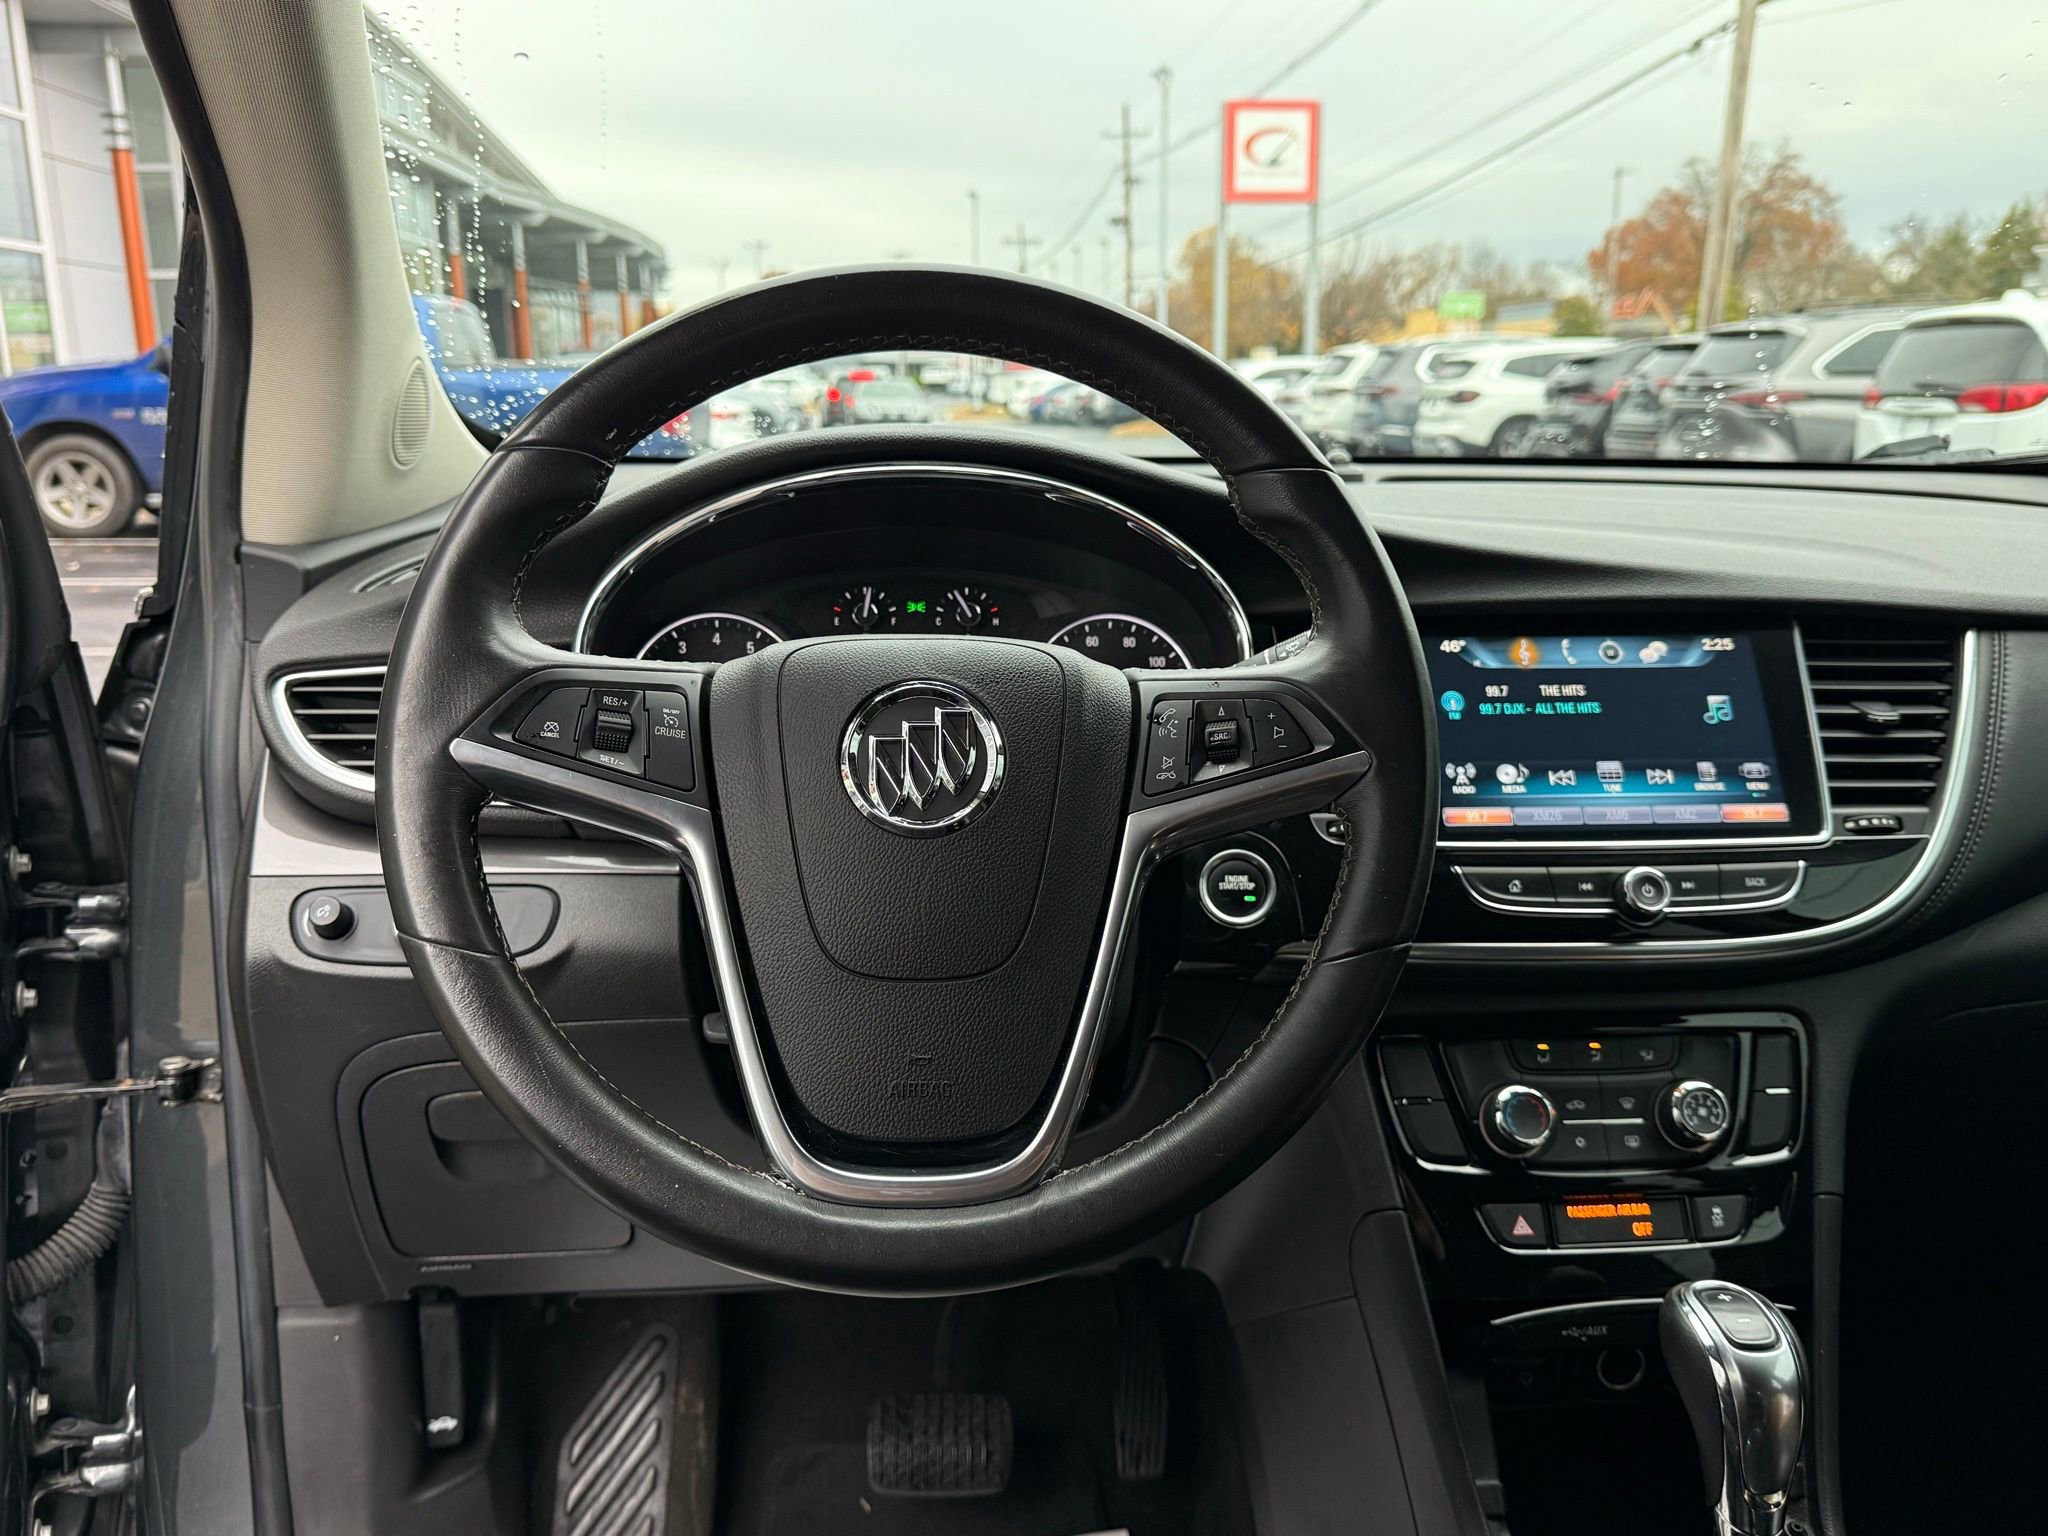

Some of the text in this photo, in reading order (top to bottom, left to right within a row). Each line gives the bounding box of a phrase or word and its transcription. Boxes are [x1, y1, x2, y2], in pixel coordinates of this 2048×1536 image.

[833, 616, 840, 626] E
[890, 616, 897, 626] F
[935, 616, 942, 626] C
[992, 617, 1000, 627] H
[712, 631, 722, 645] 4
[1086, 635, 1100, 648] 60
[1122, 636, 1136, 649] 80
[678, 641, 688, 654] 3
[746, 641, 756, 655] 5
[1149, 655, 1166, 668] 100
[1485, 684, 1587, 697] 99.7 THE HITS
[1479, 702, 1501, 715] 99.7
[1503, 702, 1526, 714] DJX
[1535, 702, 1554, 714] ALL
[1554, 702, 1577, 714] THE
[1577, 702, 1602, 714] HITS
[540, 731, 560, 739] CANCEL
[654, 725, 687, 739] CRUISE
[1213, 732, 1229, 741] SRC
[1452, 785, 1477, 794] RADIO
[1502, 785, 1528, 794] MEDIA
[1602, 783, 1623, 792] TUNE
[889, 1080, 952, 1098] AIRBAG
[1632, 1222, 1654, 1237] OFF
